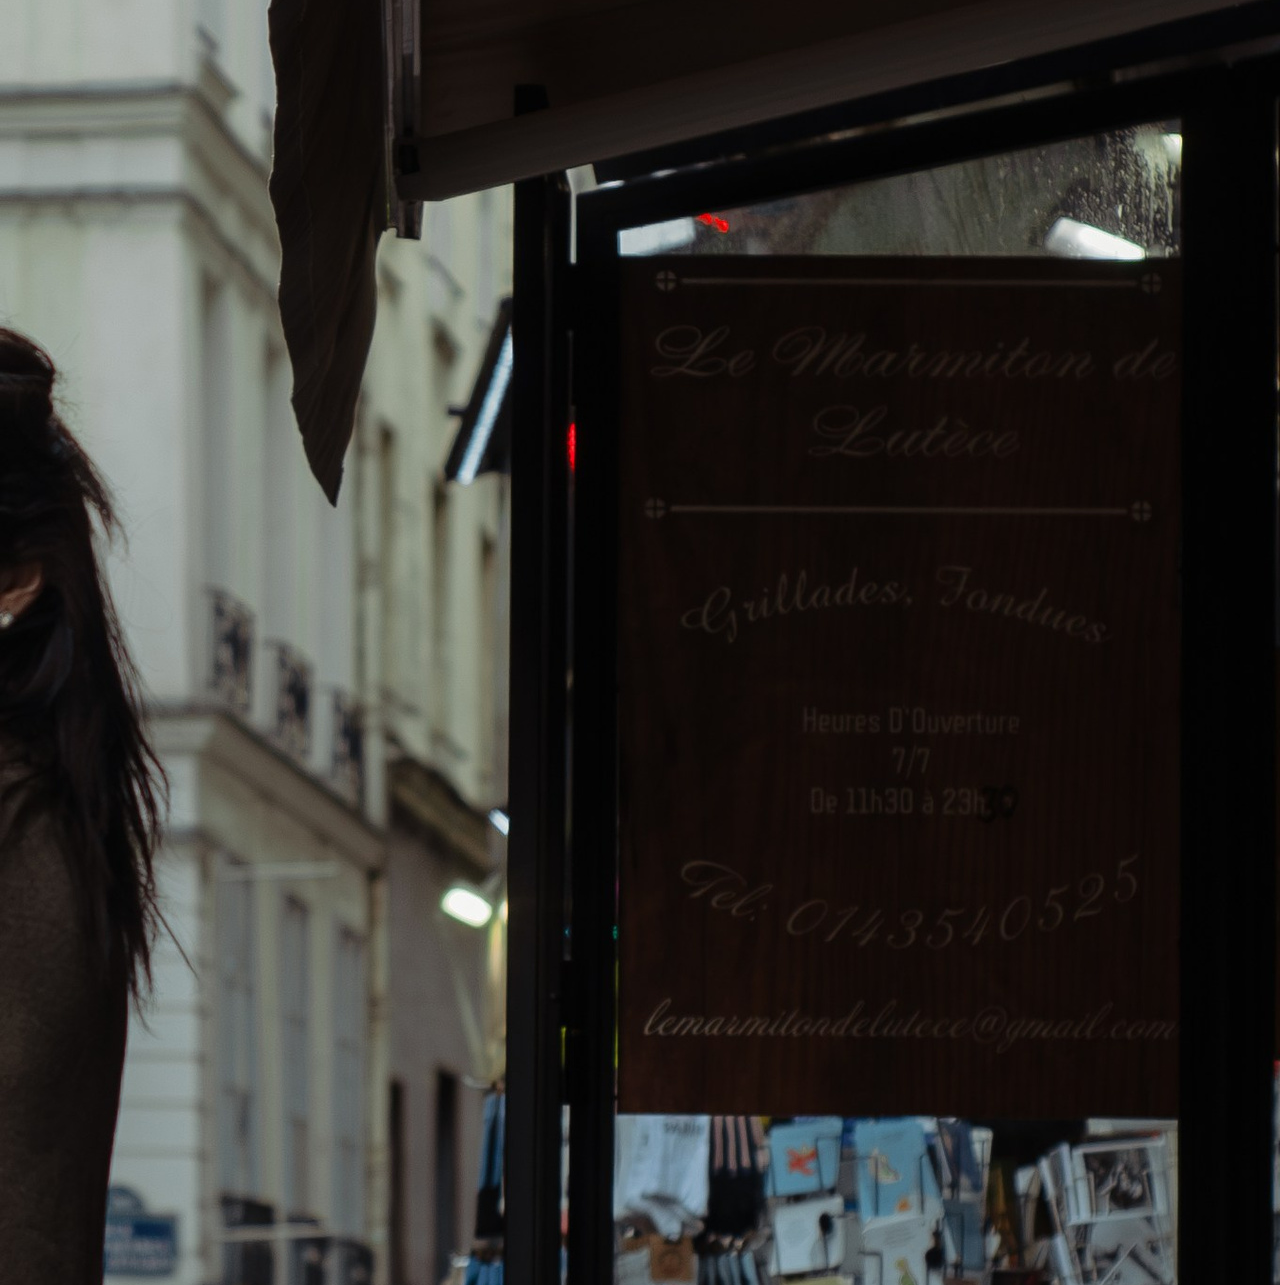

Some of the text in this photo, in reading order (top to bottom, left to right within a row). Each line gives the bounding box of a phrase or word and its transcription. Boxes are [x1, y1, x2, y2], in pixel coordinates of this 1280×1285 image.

[650, 324, 1177, 382] Le Marmiton de
[809, 404, 1021, 459] Lutèce
[681, 565, 1112, 644] Grillades, Fondues
[802, 706, 1020, 735] Heures D'Ouverture
[891, 743, 931, 780] 7/7
[810, 787, 839, 815] De
[845, 787, 914, 815] 11h30
[922, 789, 935, 815] à
[680, 860, 774, 923] Tel:
[642, 997, 1179, 1054] lemarmitondelutece@gmail.com
